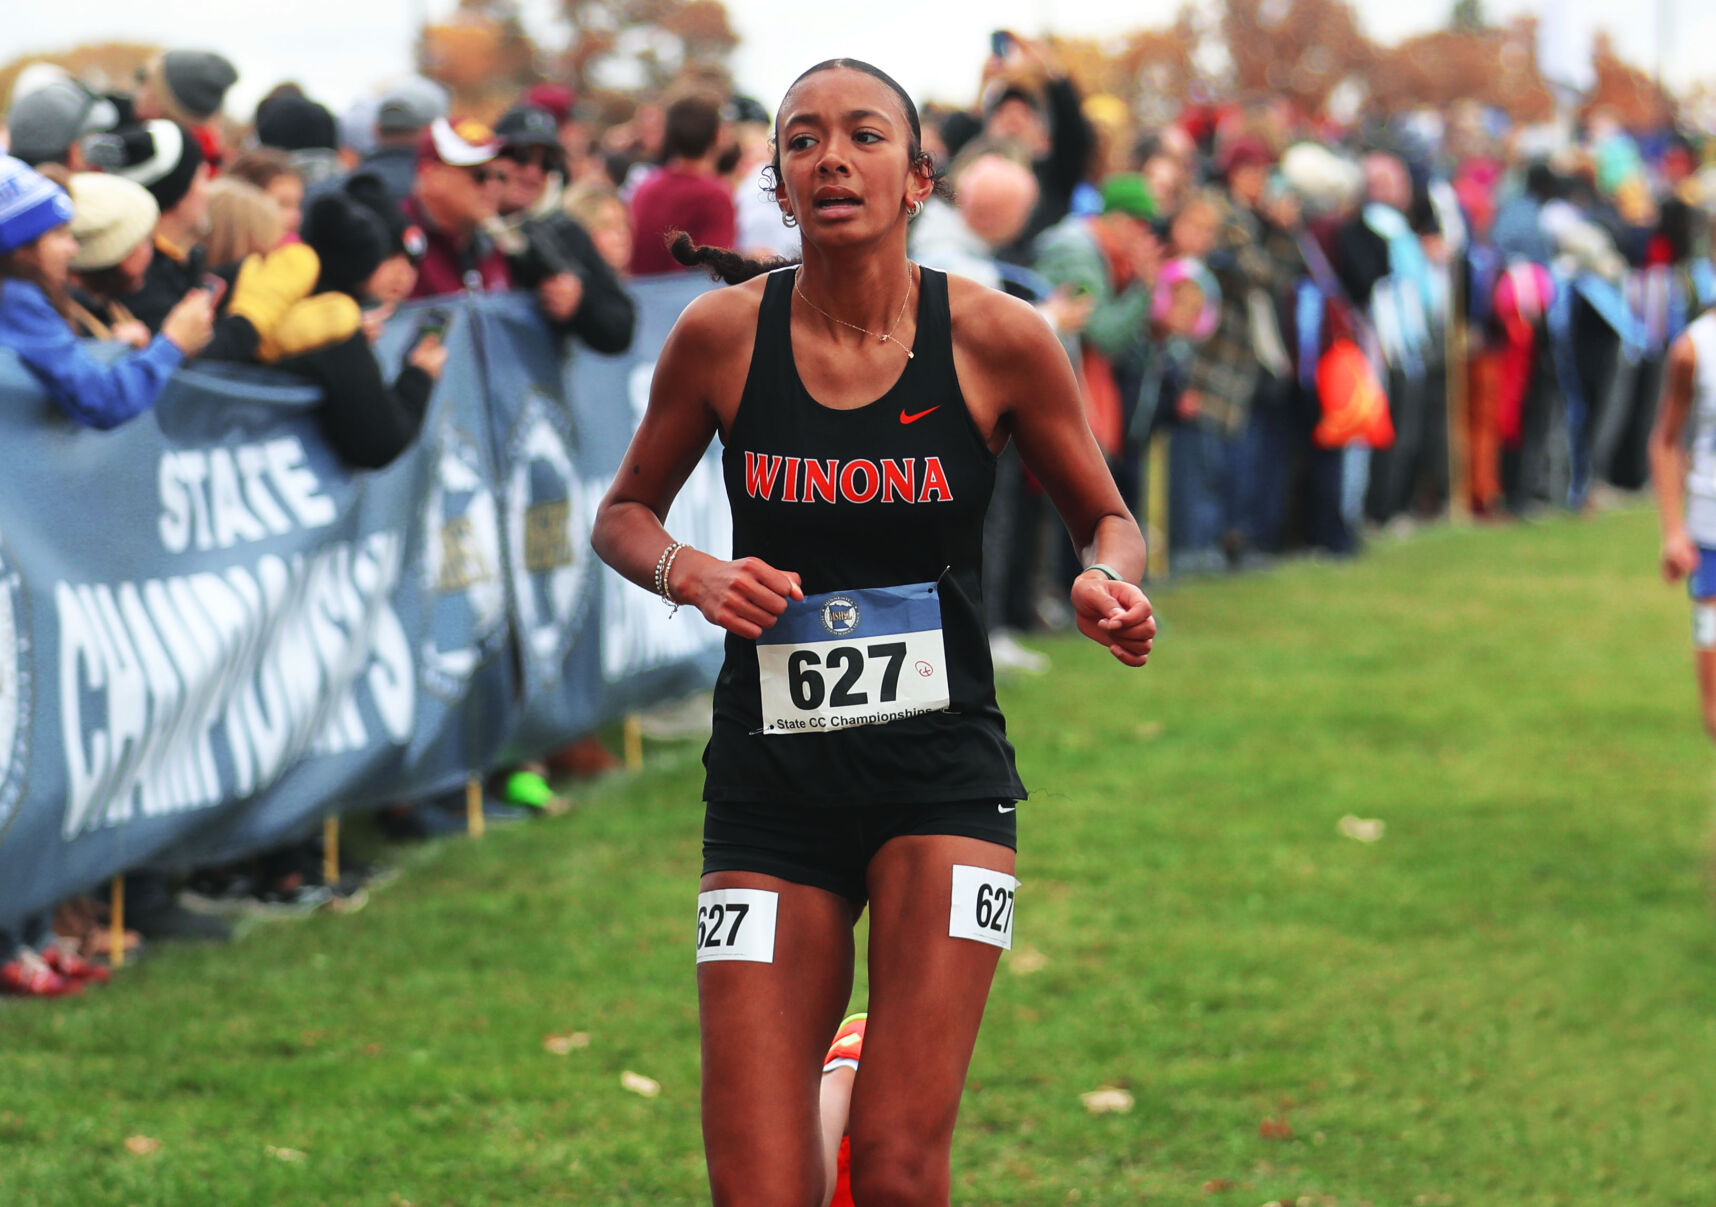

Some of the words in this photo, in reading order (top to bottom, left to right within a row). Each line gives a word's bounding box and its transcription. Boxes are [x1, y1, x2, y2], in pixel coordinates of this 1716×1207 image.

[159, 436, 336, 553] STATE
[744, 451, 954, 503] WINONA
[788, 642, 906, 710] 627
[777, 719, 807, 729] State
[809, 717, 827, 728] CC
[697, 904, 749, 949] 627
[976, 883, 1014, 933] 627
